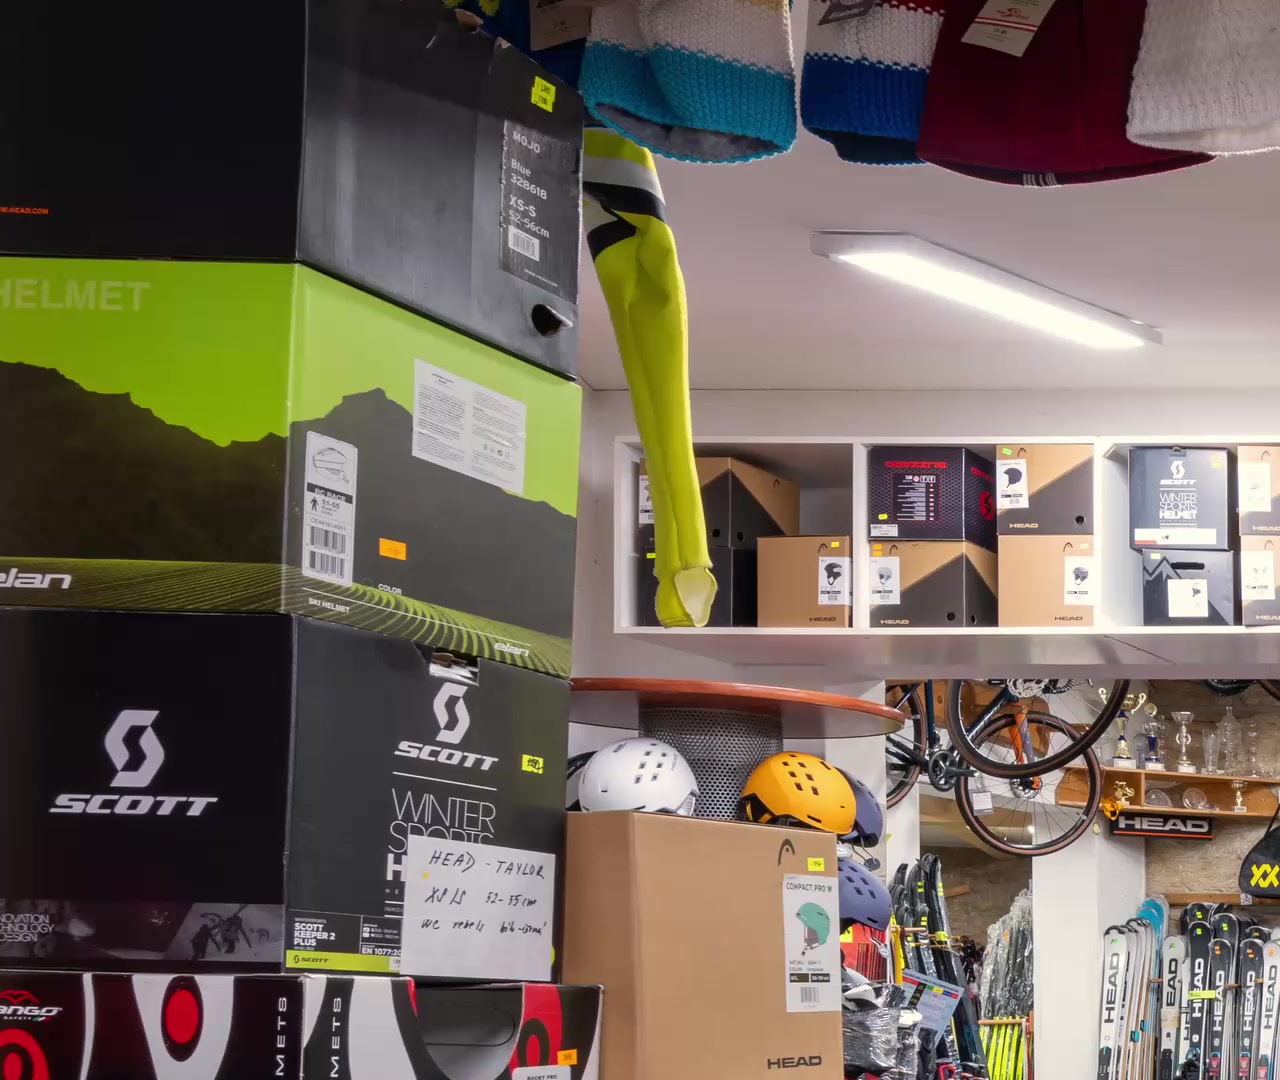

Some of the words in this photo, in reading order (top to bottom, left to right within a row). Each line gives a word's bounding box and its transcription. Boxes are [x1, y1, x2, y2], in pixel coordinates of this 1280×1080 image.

[513, 131, 541, 154] MOJO
[511, 159, 531, 177] Blue
[510, 173, 547, 200] 328618
[510, 194, 536, 217] XS-S
[509, 210, 550, 238] 52-56cm
[1160, 492, 1197, 502] WINTER
[1159, 511, 1197, 519] HELMET
[1160, 502, 1197, 511] SPORTS
[378, 583, 402, 595] COLOR
[309, 598, 320, 608] SKI
[321, 600, 350, 613] HELMET
[494, 642, 530, 657] elan
[394, 741, 499, 771] SCOTT
[49, 794, 218, 815] SCOTT
[392, 788, 496, 833] WINTER
[1118, 816, 1209, 833] HEAD
[429, 851, 476, 873] HEAD
[497, 860, 545, 880] TAYLOR
[786, 882, 813, 892] COMPACT
[814, 883, 826, 892] PRO
[294, 922, 324, 932] SCOTT
[294, 930, 329, 940] KEEPER
[329, 932, 336, 940] 2
[294, 938, 316, 947] PLUS
[362, 947, 373, 955] EN
[1104, 952, 1120, 1023] HEAD
[1213, 969, 1225, 1031] HEAD
[1243, 970, 1256, 1031] HEAD
[1264, 964, 1277, 1030] HEAD
[767, 1056, 822, 1070] HEAD
